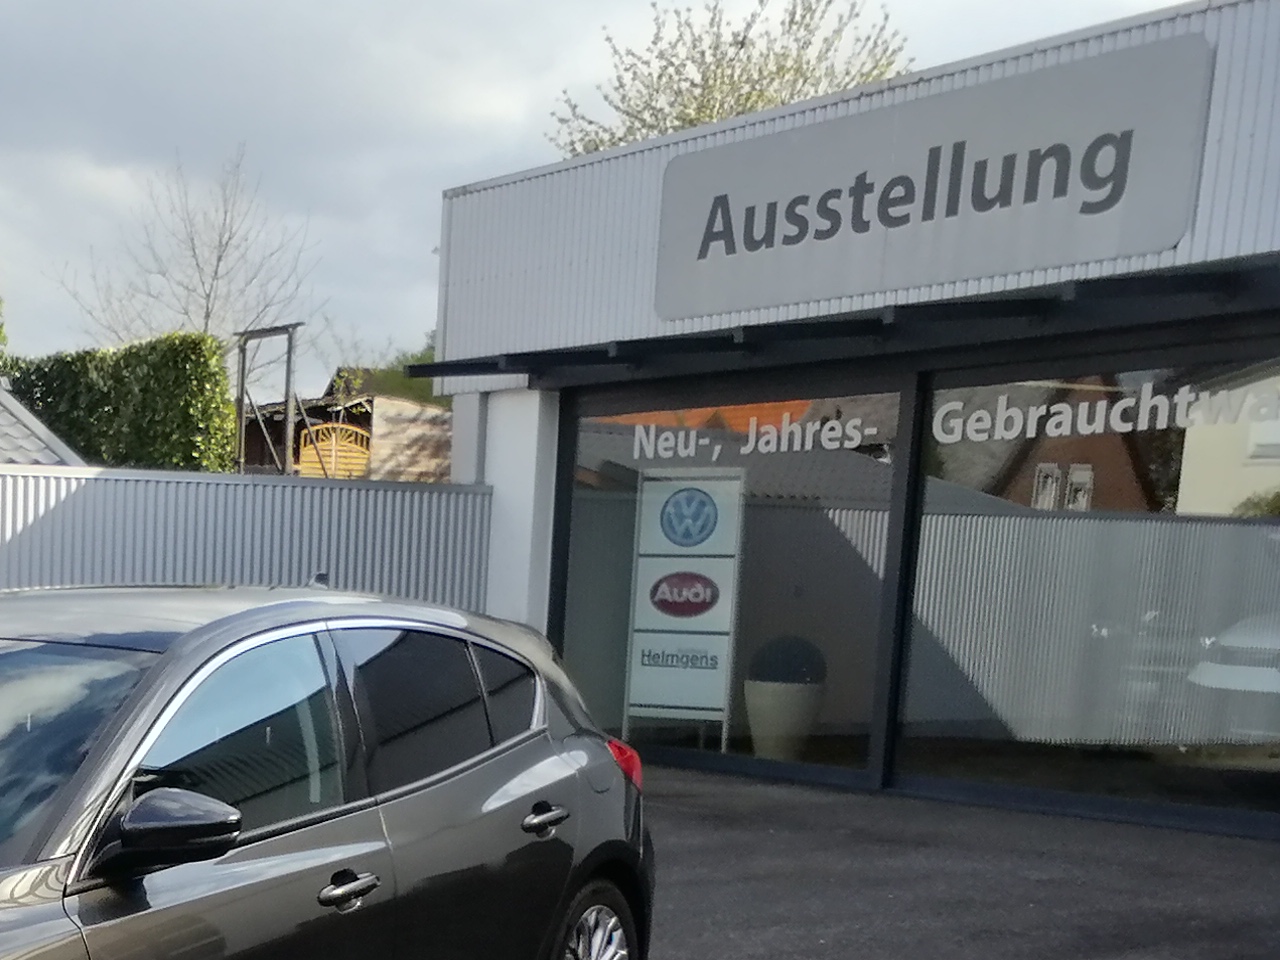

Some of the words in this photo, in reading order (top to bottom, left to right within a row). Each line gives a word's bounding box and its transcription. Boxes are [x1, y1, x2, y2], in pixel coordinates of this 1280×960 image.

[697, 129, 1134, 260] Ausstellung
[633, 424, 722, 461] Neu-,
[740, 412, 878, 455] Jahres-
[662, 489, 717, 546] VW
[653, 581, 713, 603] Audi
